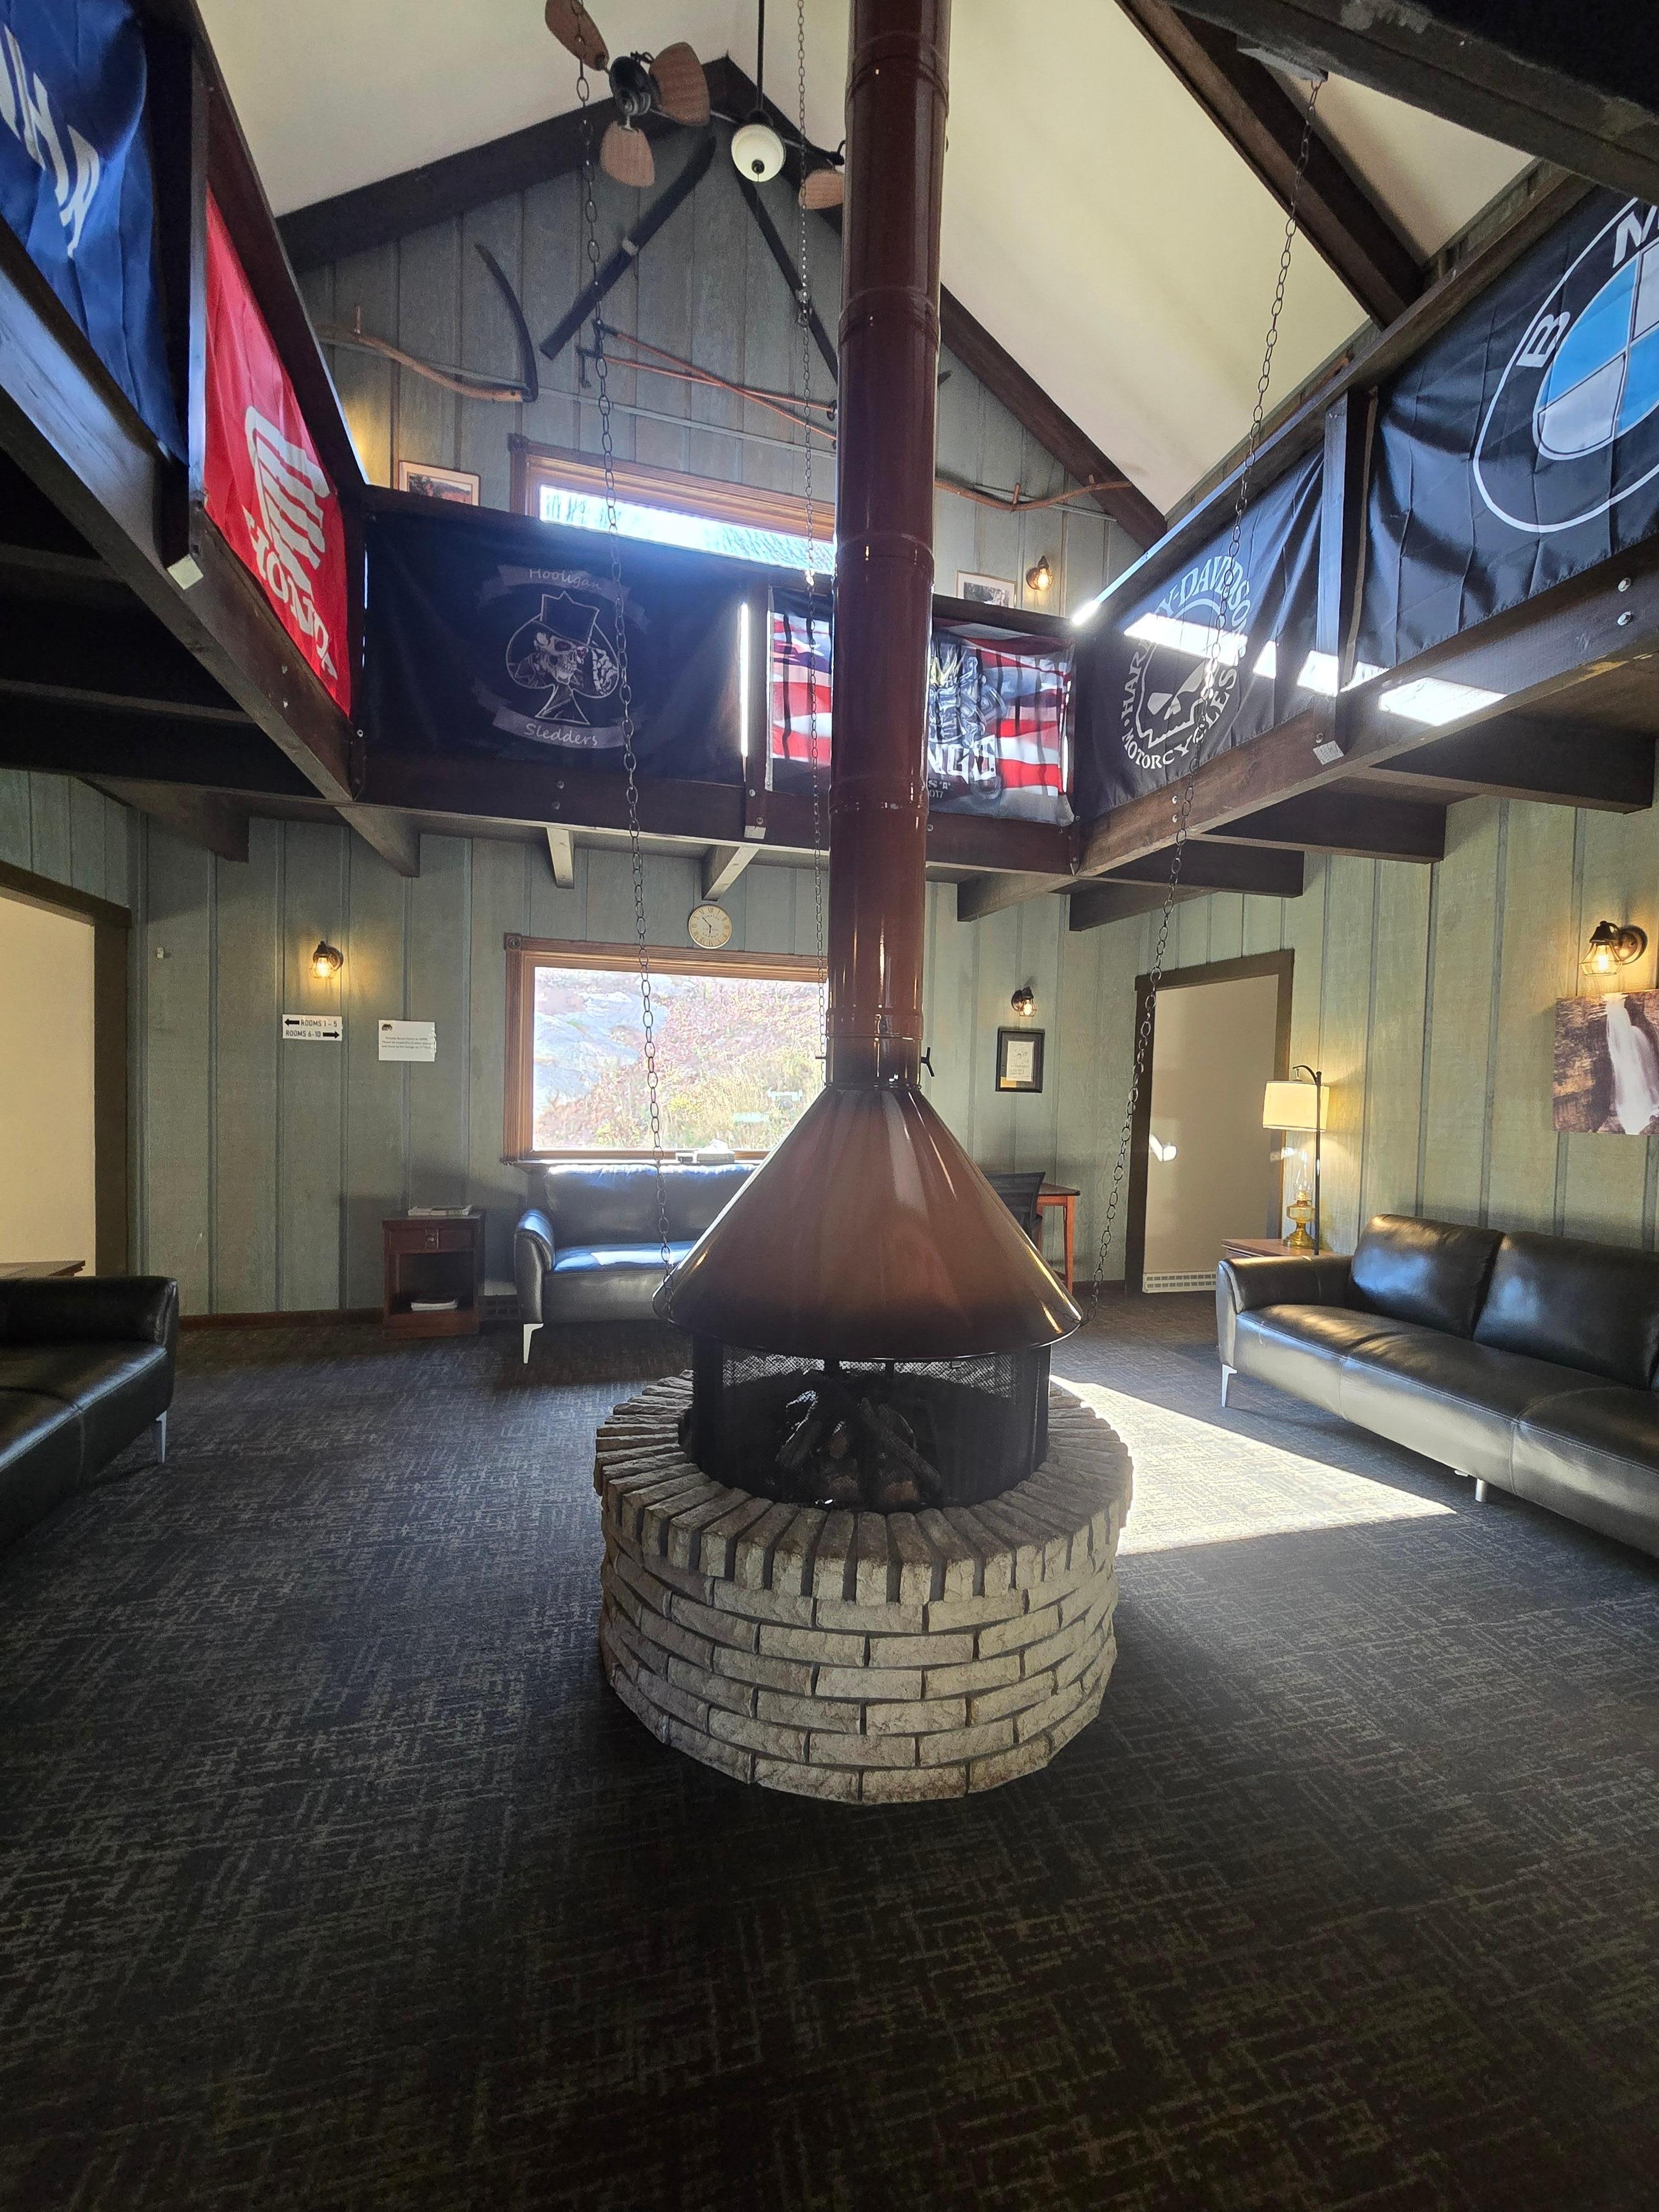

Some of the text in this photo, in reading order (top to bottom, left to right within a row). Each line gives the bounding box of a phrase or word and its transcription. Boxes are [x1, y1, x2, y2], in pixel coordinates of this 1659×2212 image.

[529, 568, 602, 590] Hooligan
[525, 722, 598, 746] Sledders
[929, 790, 943, 798] 017
